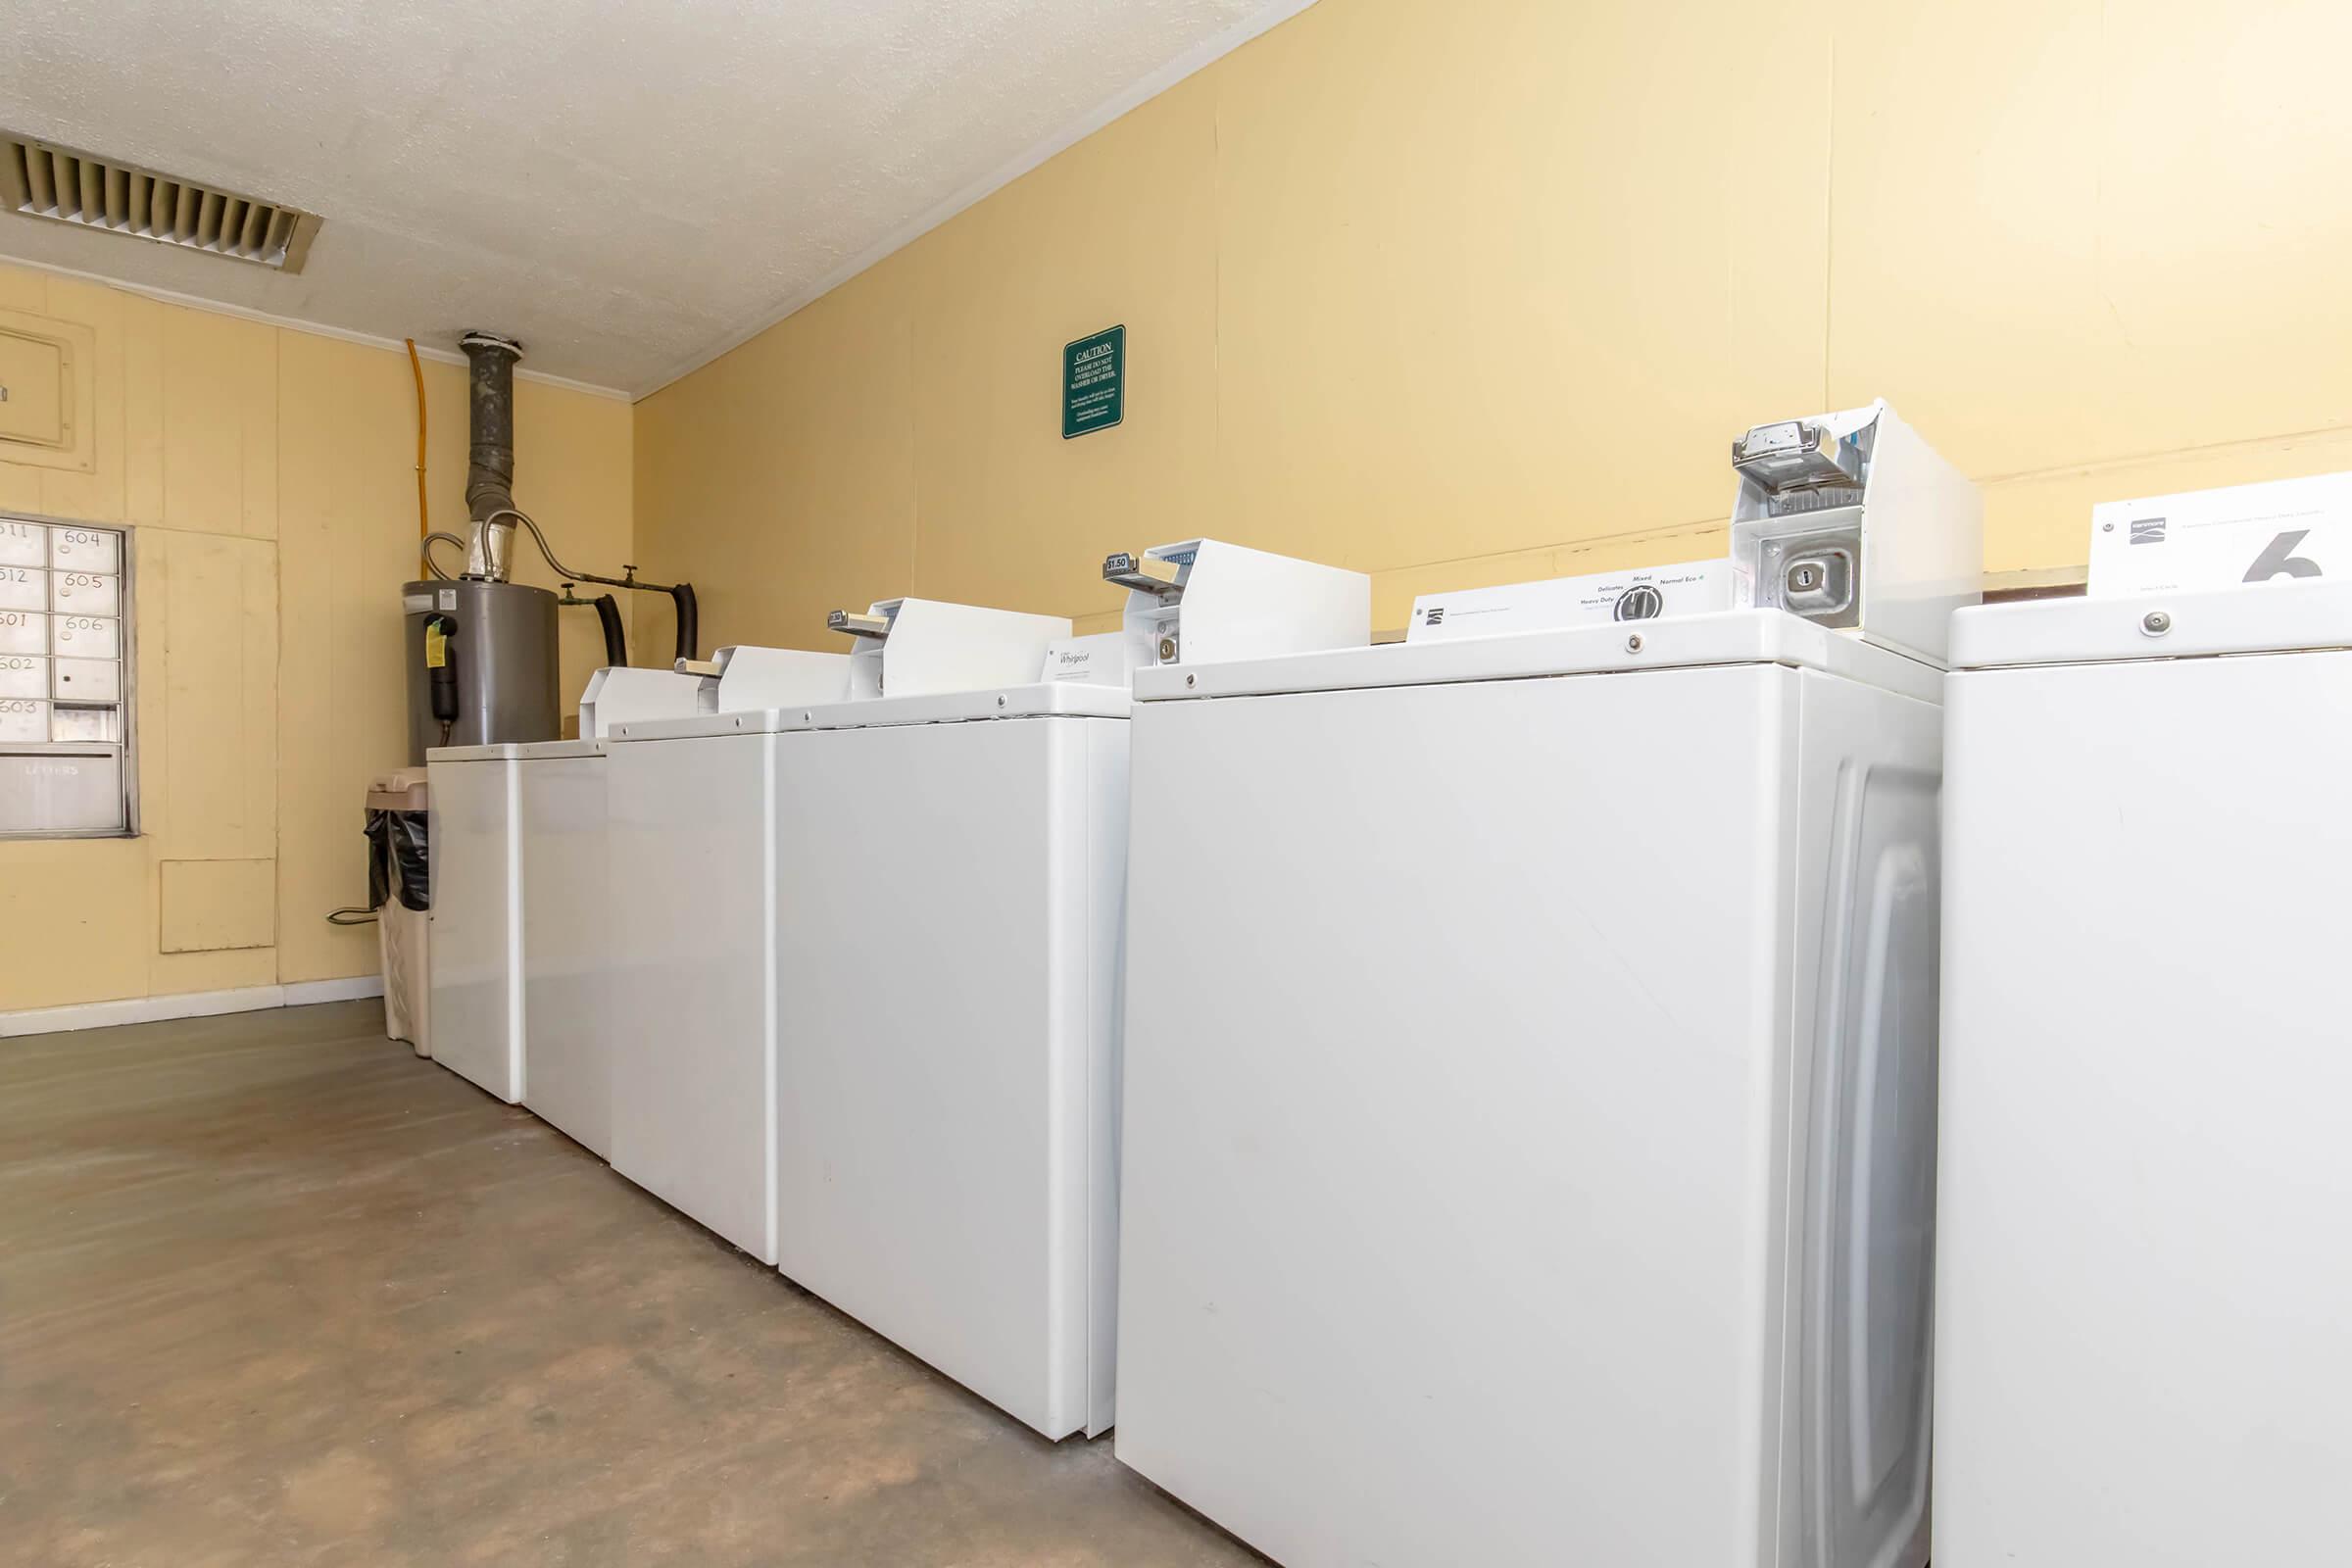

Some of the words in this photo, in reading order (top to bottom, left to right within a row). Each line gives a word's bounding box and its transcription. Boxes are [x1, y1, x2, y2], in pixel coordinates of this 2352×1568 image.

[1076, 341, 1112, 362] CAUTION
[1074, 368, 1102, 381] OVERLOAD
[1102, 364, 1112, 372] THE
[1075, 363, 1092, 374] PLEASE
[1101, 356, 1112, 366] NOT
[1071, 378, 1091, 390] WASHER
[65, 530, 100, 547] 604
[1107, 558, 1126, 569] $1.50
[2242, 529, 2323, 583] 6
[65, 572, 103, 588] 605
[66, 616, 103, 630] 606
[0, 701, 37, 713] 603
